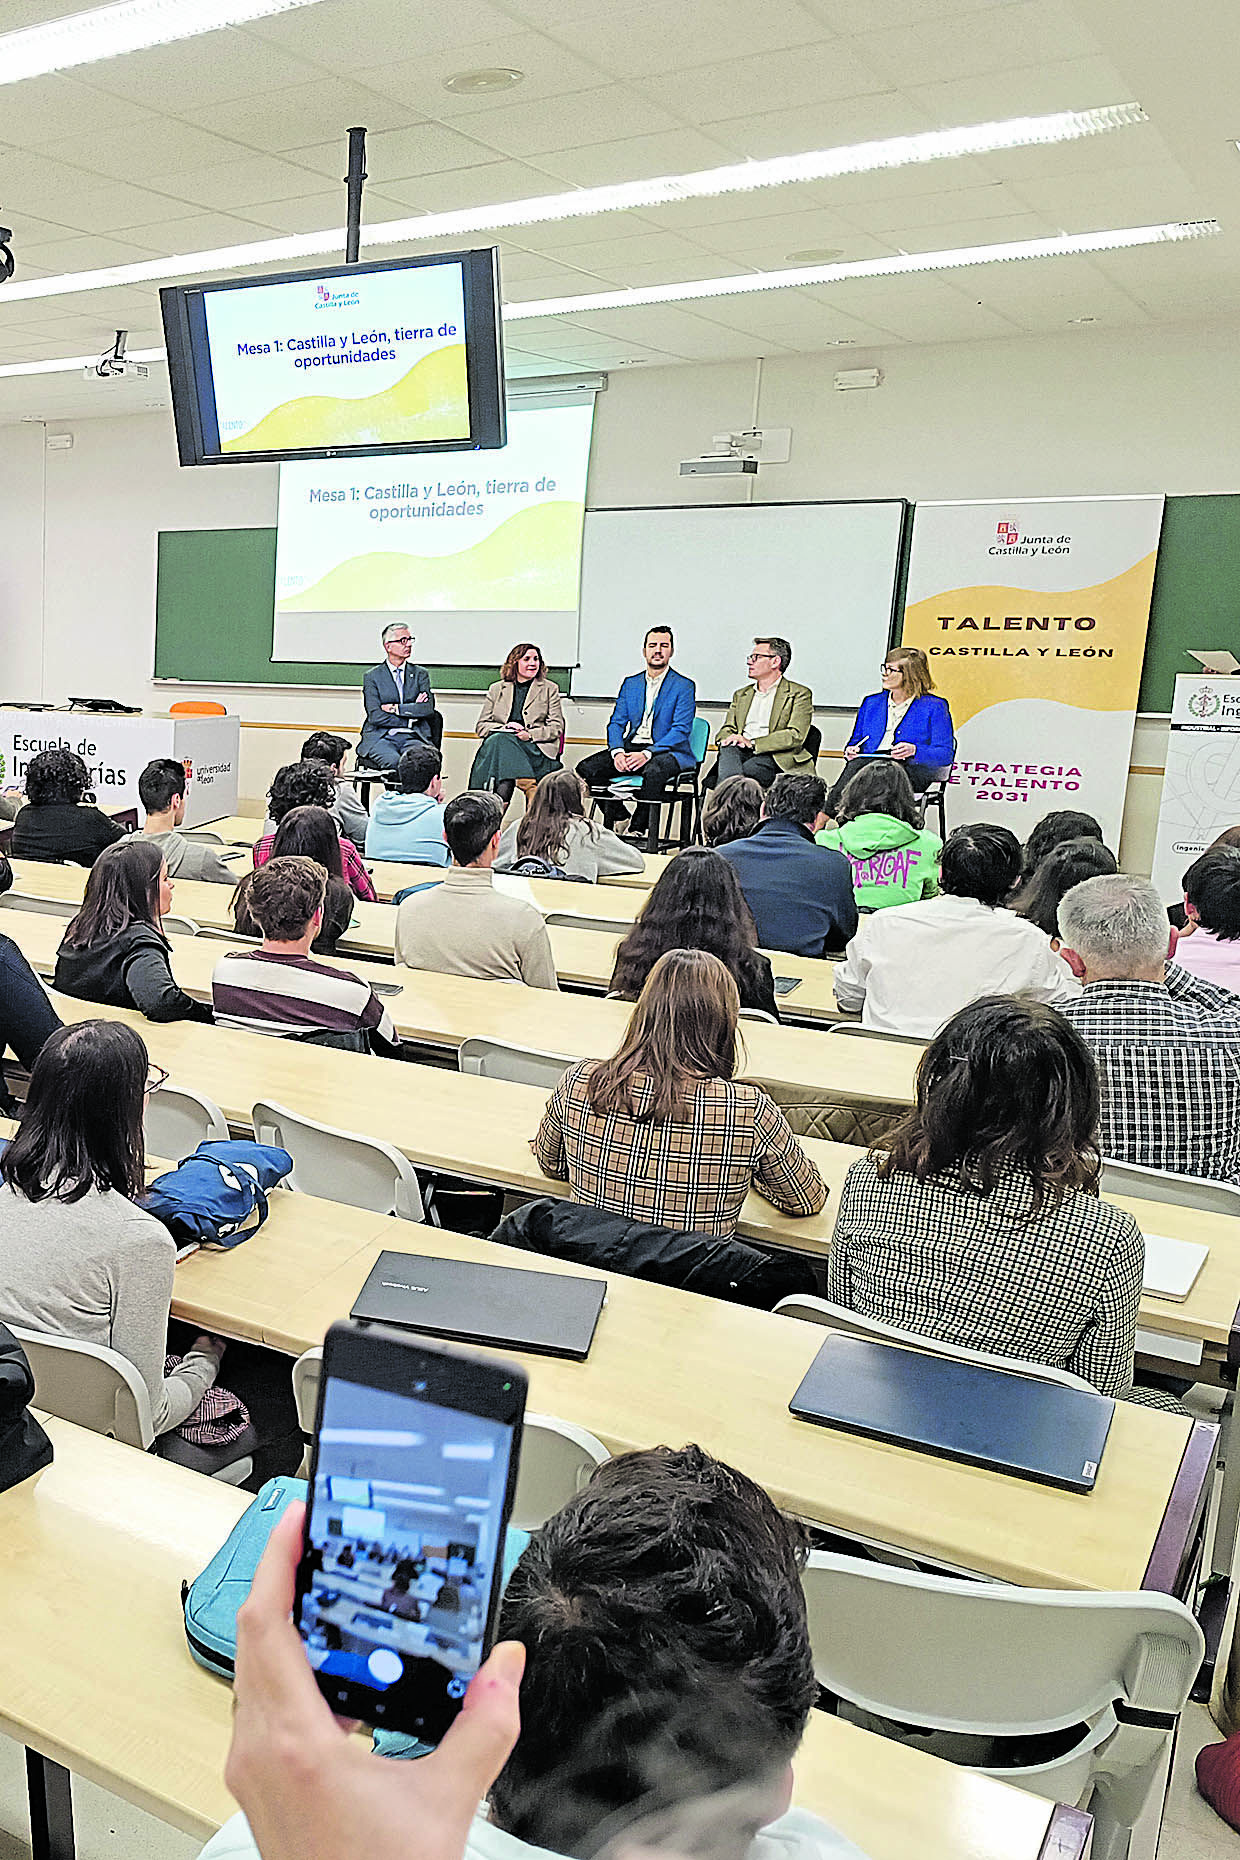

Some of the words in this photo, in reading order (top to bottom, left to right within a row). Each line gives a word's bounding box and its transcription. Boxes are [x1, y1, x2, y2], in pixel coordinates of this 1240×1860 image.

[237, 343, 271, 356] Mesa
[274, 340, 284, 352] 1:
[287, 336, 336, 352] Castilla
[339, 336, 348, 348] y
[352, 330, 391, 346] León,
[394, 326, 434, 342] tierra
[438, 323, 458, 337] de
[294, 347, 396, 370] oportunidades
[310, 488, 346, 504] Mesa
[350, 488, 360, 501] 1:
[364, 483, 418, 500] Castilla
[422, 485, 432, 500] y
[437, 480, 480, 498] León,
[486, 479, 530, 495] tierra
[534, 476, 556, 492] de
[369, 501, 484, 522] oportunidades
[1020, 536, 1054, 544] Junta
[1056, 535, 1072, 544] de
[988, 546, 1028, 555] Castilla
[1030, 548, 1038, 556] y
[1042, 546, 1070, 554] León
[938, 616, 1096, 631] TALENTO
[928, 646, 1030, 657] CASTILLA
[1037, 648, 1050, 657] Y
[1056, 646, 1114, 658] LEÓN
[1224, 694, 1240, 704] Esc
[1222, 705, 1240, 719] Ing
[13, 734, 70, 752] Escuela
[78, 738, 97, 756] de
[13, 756, 126, 786] Inrías
[196, 762, 231, 776] universidad
[952, 762, 1082, 777] STRATEGIA
[949, 776, 960, 784] E
[968, 776, 1080, 791] TALENTO
[976, 790, 1029, 802] 2031
